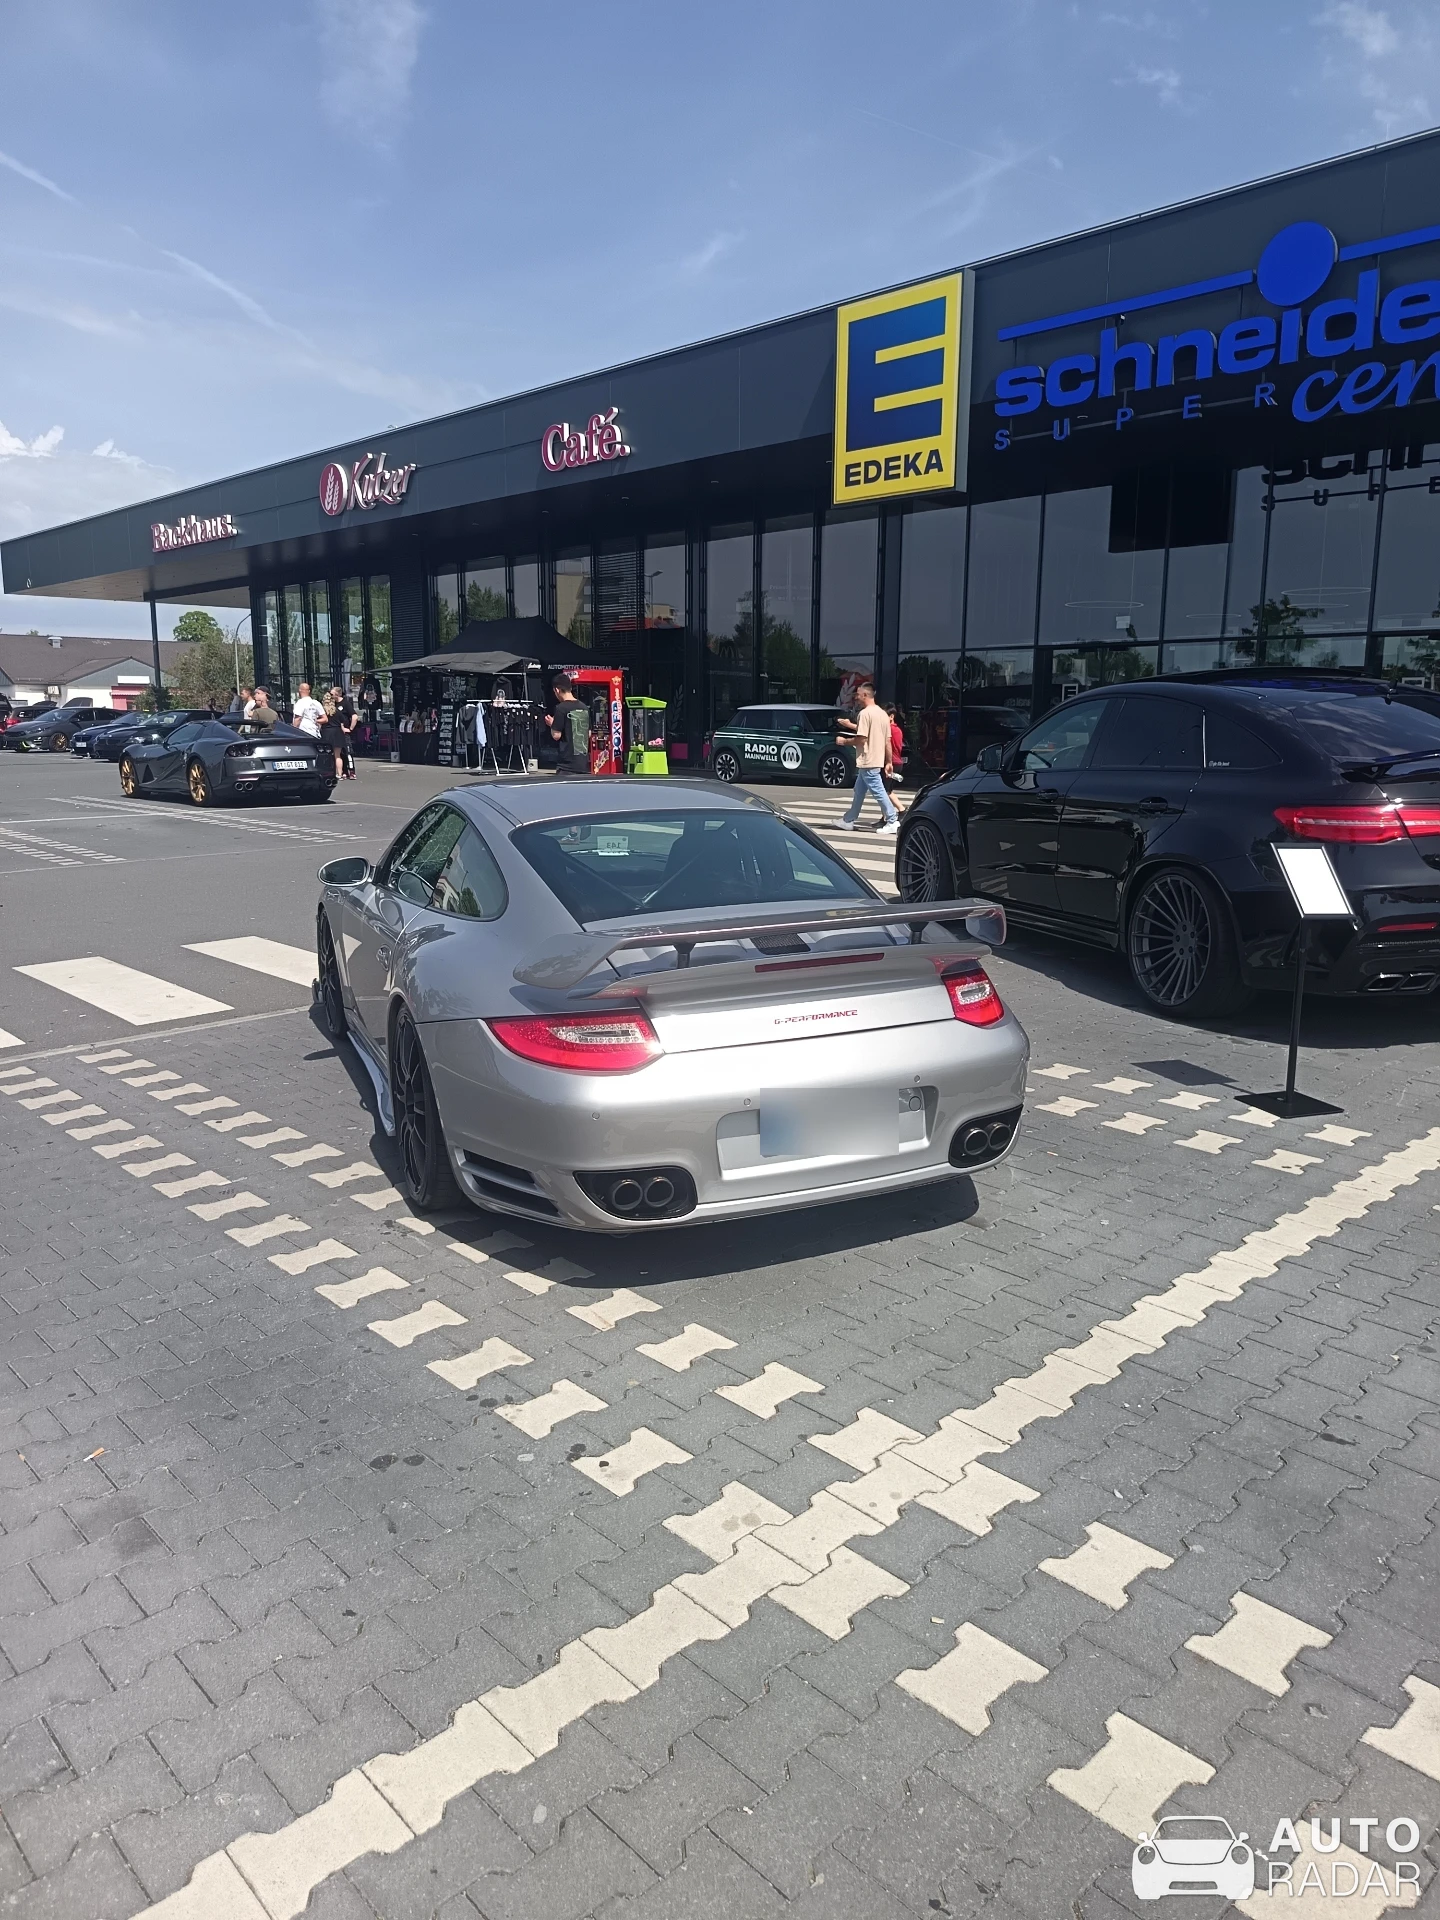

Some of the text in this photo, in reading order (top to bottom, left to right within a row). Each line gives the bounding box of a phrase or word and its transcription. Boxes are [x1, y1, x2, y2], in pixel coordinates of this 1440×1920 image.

[994, 382, 1279, 450] SUPER
[542, 406, 631, 472] Café.
[844, 448, 944, 487] EDEKA
[151, 514, 238, 552] Backhaus.
[744, 743, 778, 755] RADIO
[744, 752, 778, 762] MAINWELLE
[774, 1009, 859, 1025] G-PERFORMANCE
